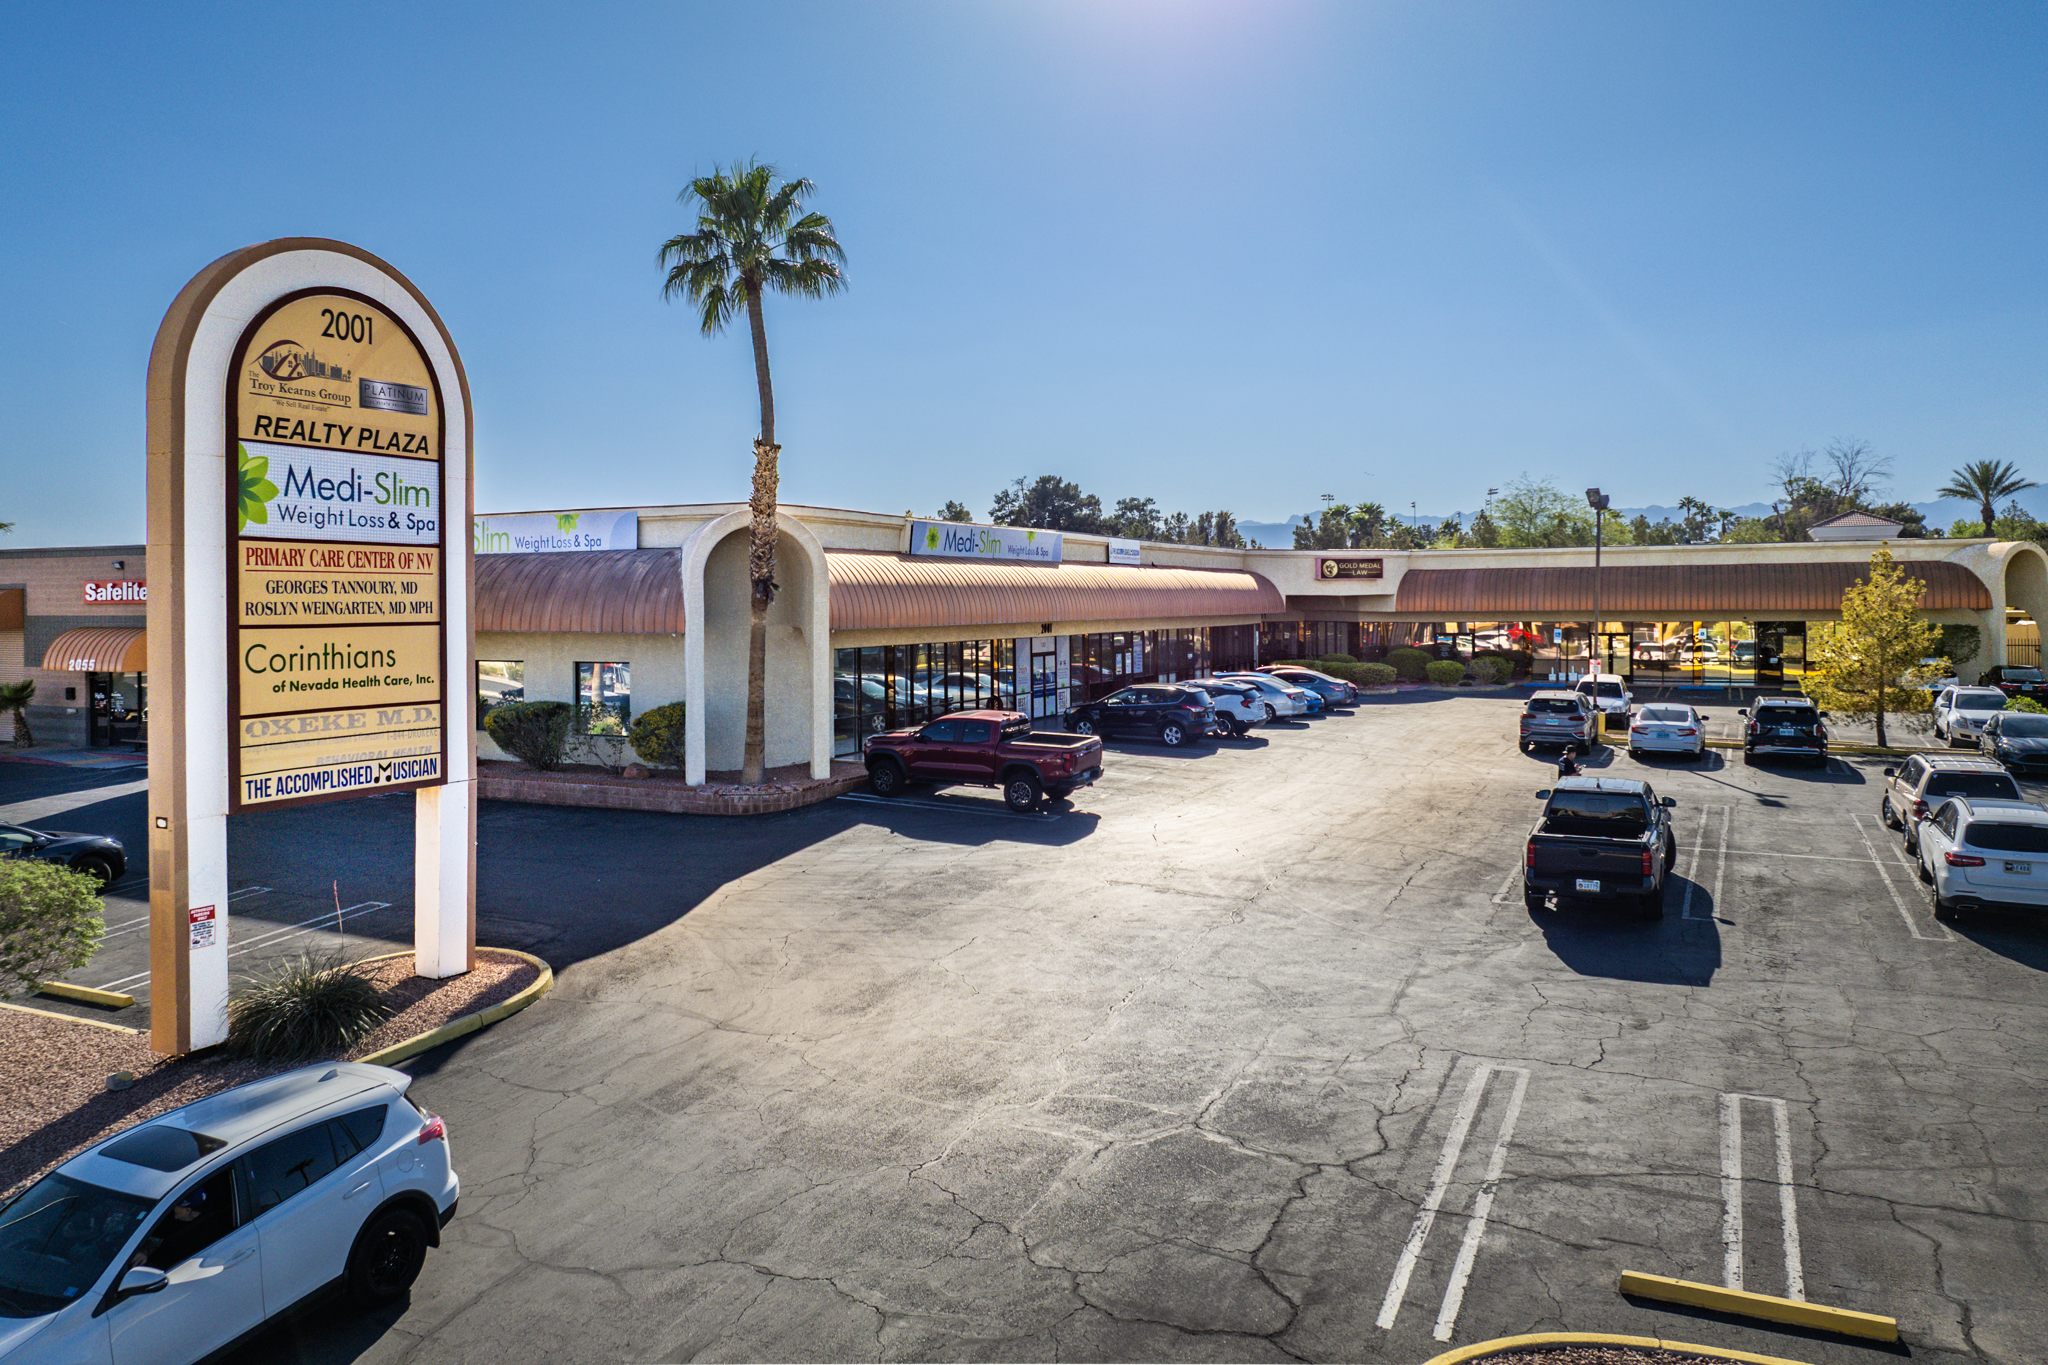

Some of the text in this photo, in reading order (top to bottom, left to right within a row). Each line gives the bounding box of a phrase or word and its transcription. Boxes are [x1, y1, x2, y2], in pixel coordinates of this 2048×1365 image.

[321, 309, 373, 345] 2001
[249, 370, 260, 378] The
[250, 378, 351, 405] Troy Kearns Group
[364, 384, 425, 402] PLATINUM
[298, 402, 311, 410] Real
[254, 415, 429, 455] REALTY PLAZA
[284, 464, 430, 507] Medi-Slim
[278, 504, 435, 536] Weight Loss & Spa
[515, 535, 549, 552] Weight
[552, 536, 572, 549] Loss
[574, 534, 581, 548] &
[584, 534, 602, 550] Spa
[944, 528, 1049, 558] Medi-Slim Weight Loss & Spa
[245, 547, 433, 570] PRIMARY CARE CENTER OF NV
[85, 582, 147, 601] Safelite
[266, 579, 418, 596] GEORGES TANNOURY, MD
[245, 601, 433, 616] ROSLYN WEINGARTEN, MD MPH
[68, 659, 96, 671] 2055
[245, 643, 396, 674] Corinthians
[272, 674, 435, 693] of Nevada Health Care, Inc.
[245, 707, 437, 738] OXEKE M.D.
[245, 778, 272, 800] THE
[275, 765, 372, 796] ACCOMPLISHED
